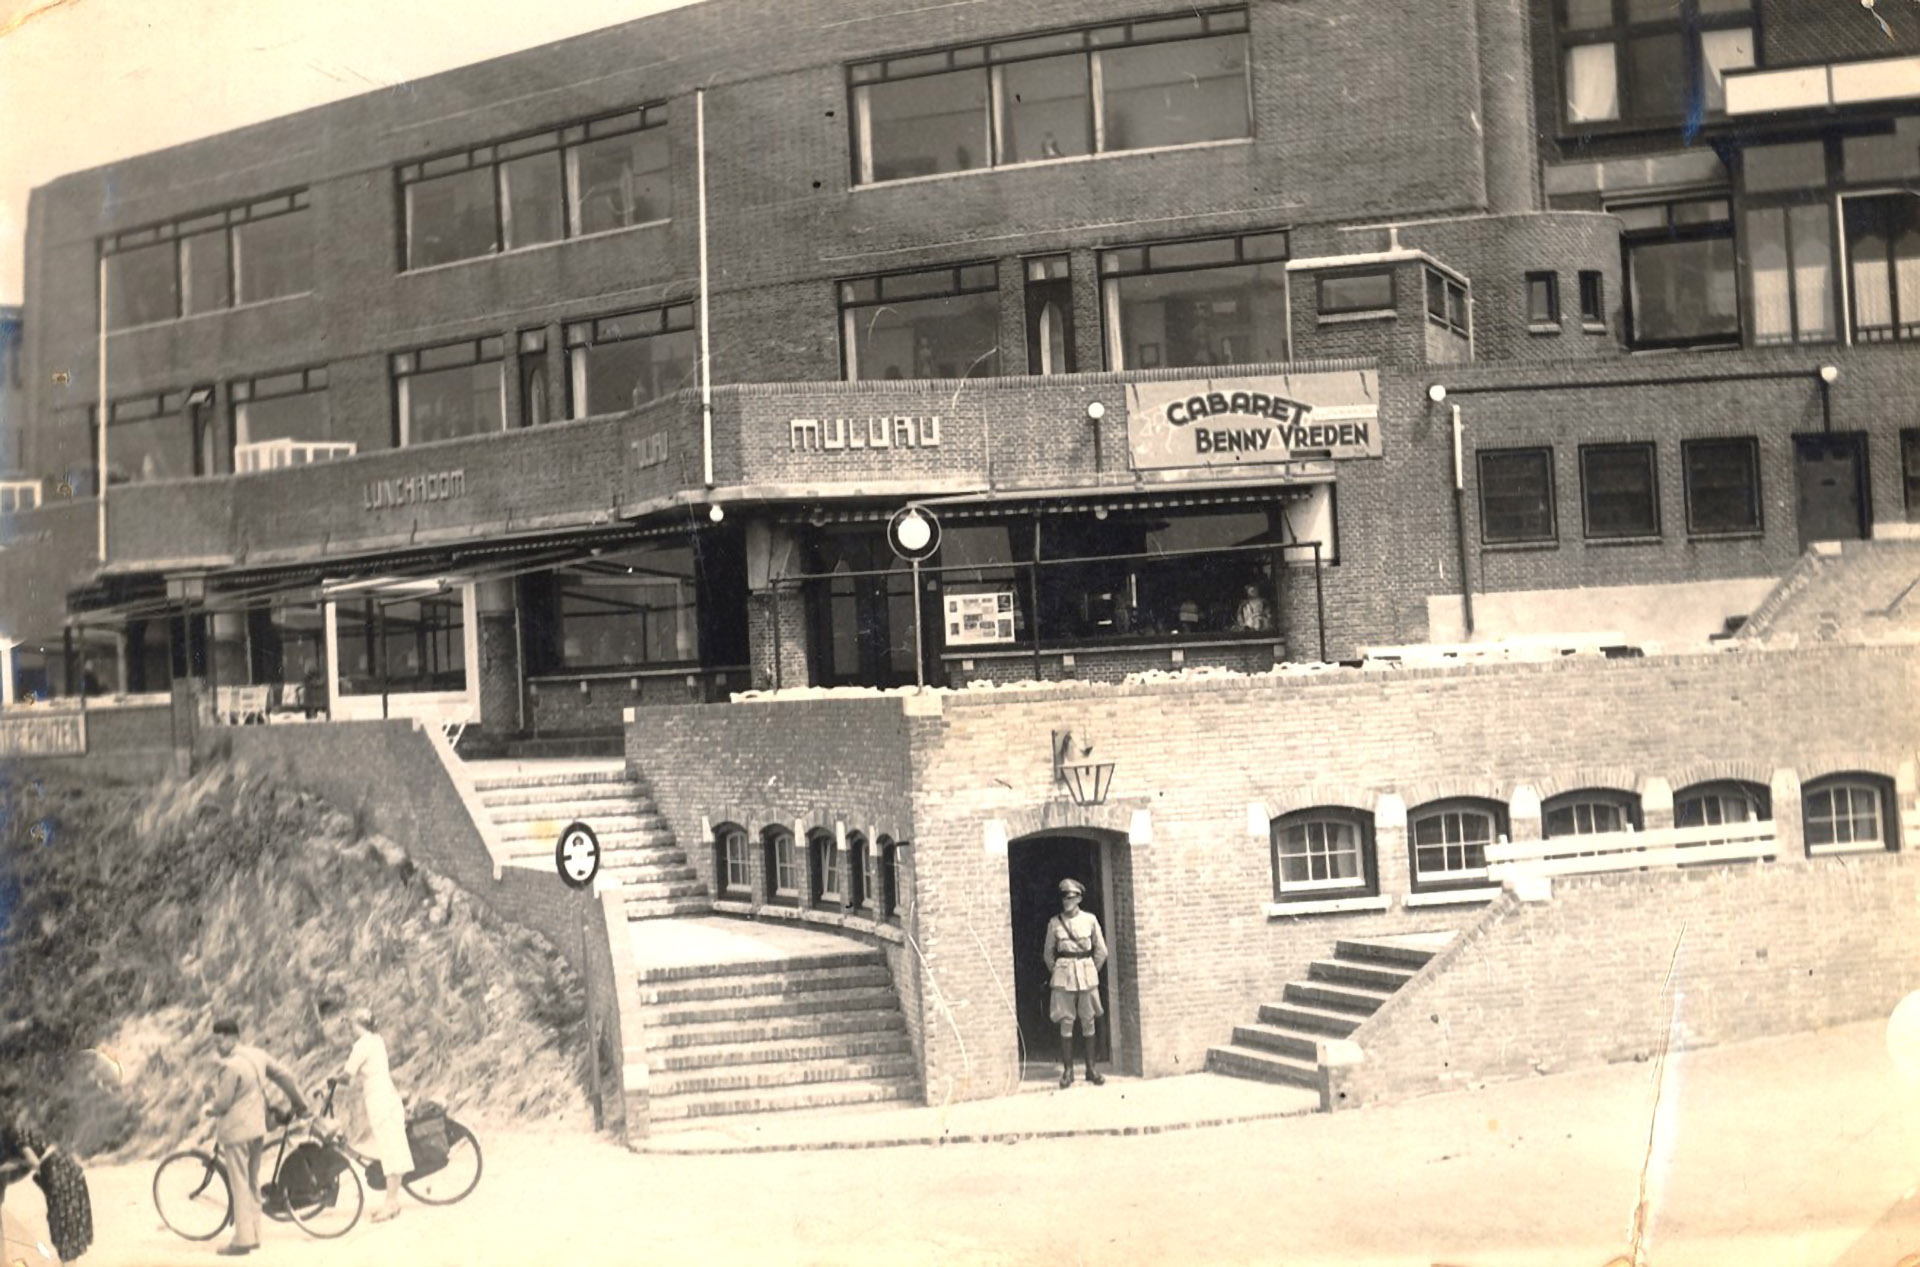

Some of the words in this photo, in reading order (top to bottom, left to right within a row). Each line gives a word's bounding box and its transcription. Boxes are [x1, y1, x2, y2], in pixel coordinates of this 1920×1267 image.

[1166, 392, 1313, 427] CABARET
[1195, 427, 1272, 453] BENNY
[1278, 422, 1369, 450] VREDEN
